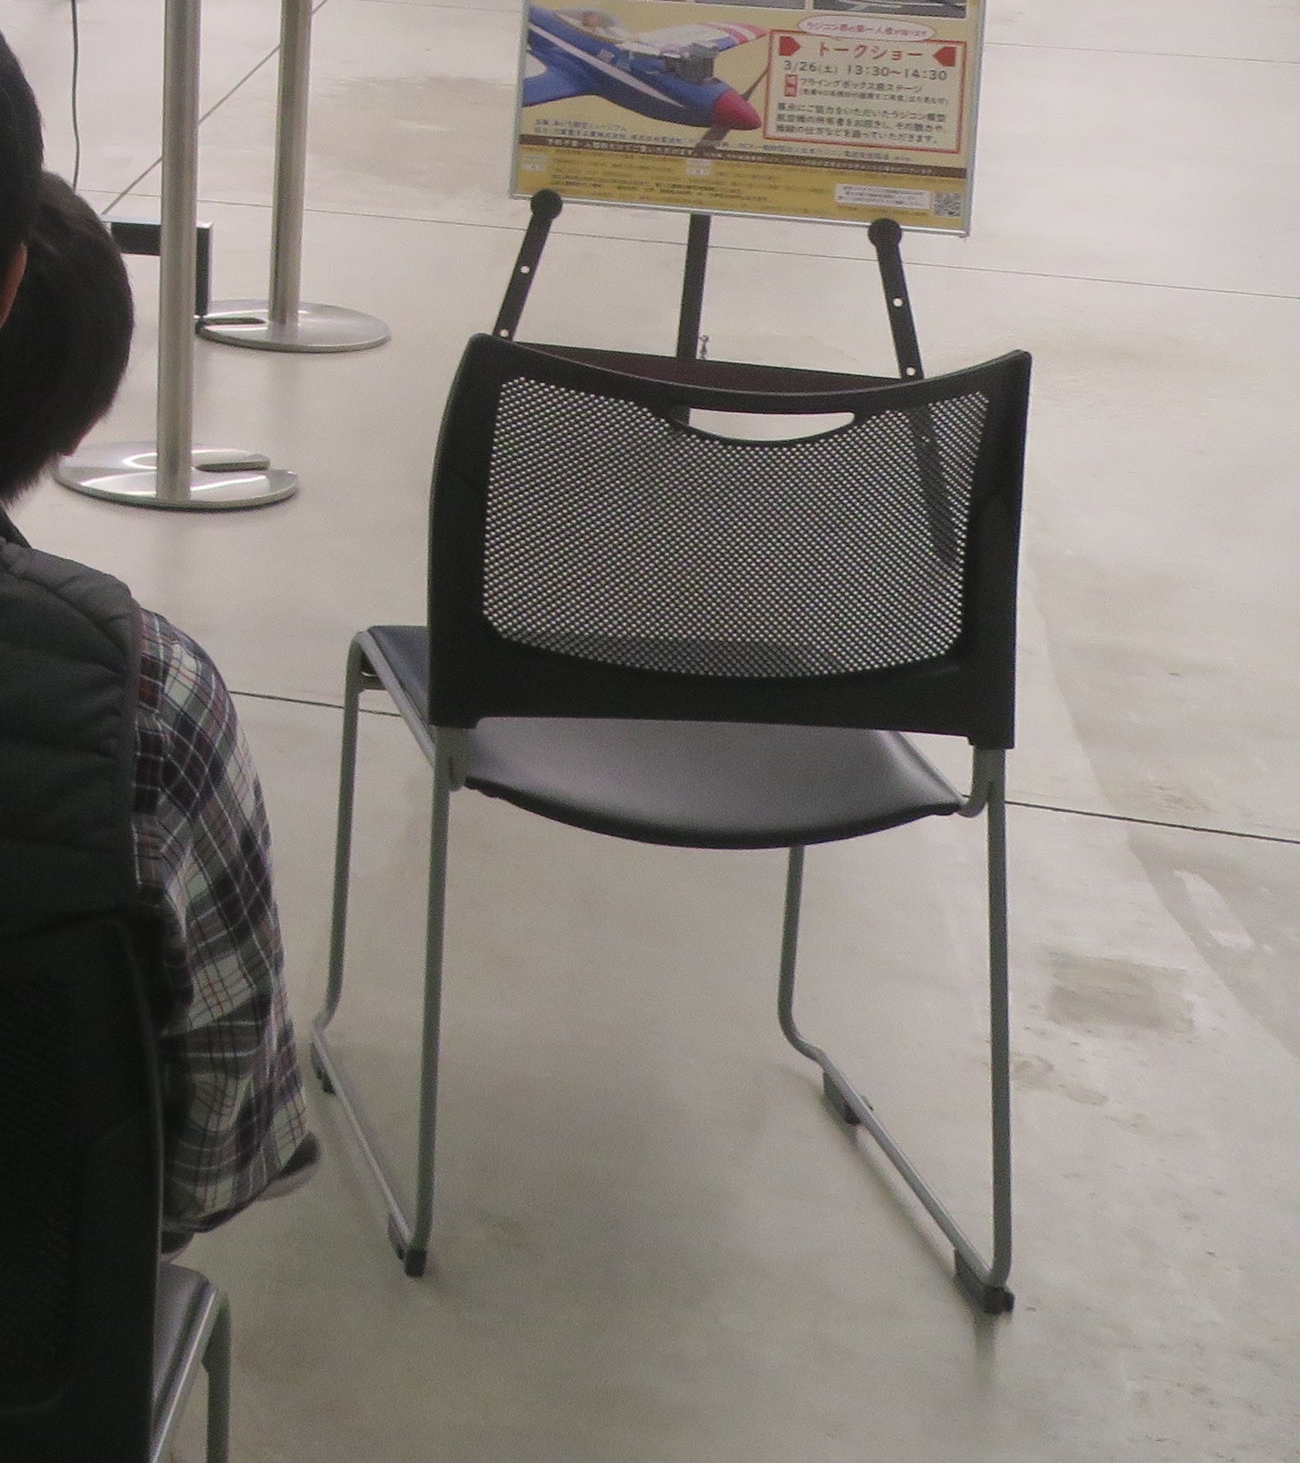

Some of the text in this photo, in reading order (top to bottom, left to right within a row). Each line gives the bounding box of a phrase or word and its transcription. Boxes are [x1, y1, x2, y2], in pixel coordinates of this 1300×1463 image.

[818, 41, 923, 61] トークショー
